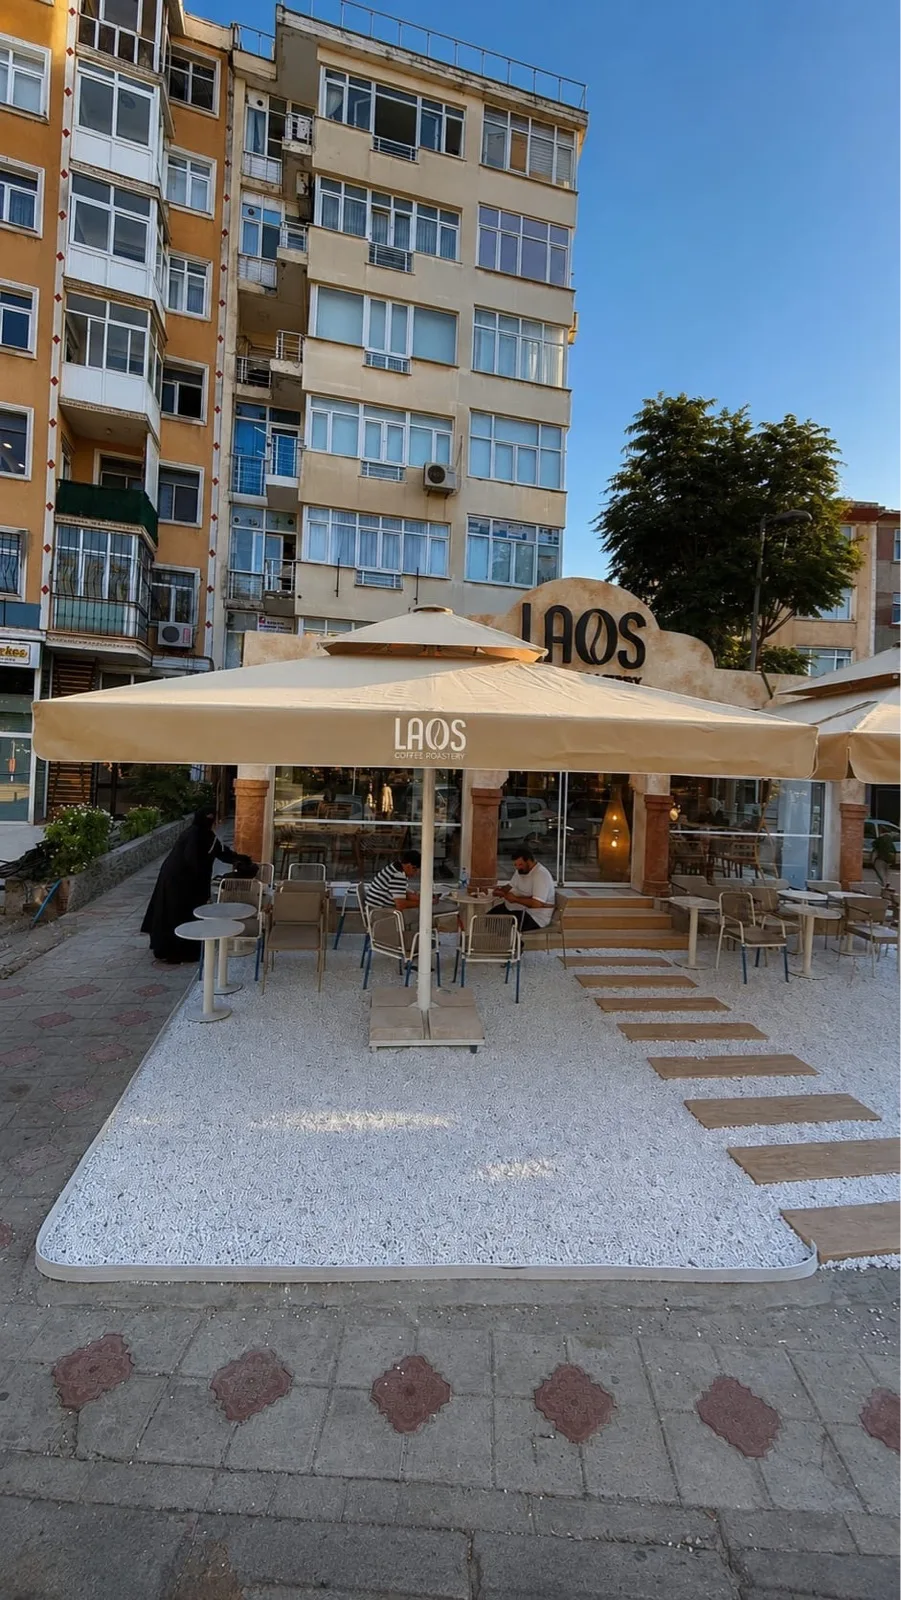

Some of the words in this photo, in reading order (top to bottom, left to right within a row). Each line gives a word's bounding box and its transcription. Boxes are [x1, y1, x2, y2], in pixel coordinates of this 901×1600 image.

[394, 717, 467, 752] LAOS
[394, 751, 423, 760] COFFEE
[425, 752, 466, 761] ROASTERY
